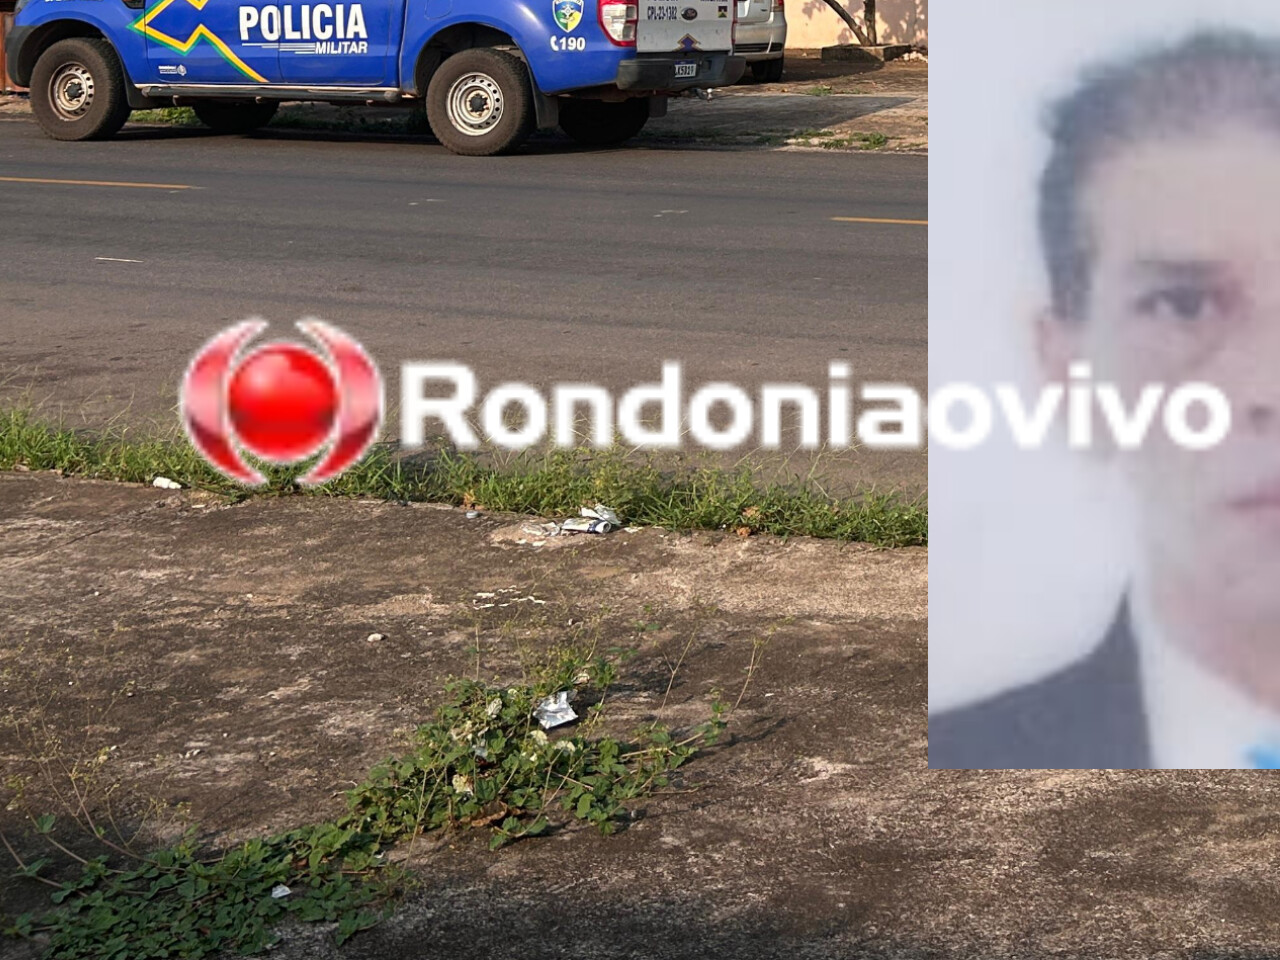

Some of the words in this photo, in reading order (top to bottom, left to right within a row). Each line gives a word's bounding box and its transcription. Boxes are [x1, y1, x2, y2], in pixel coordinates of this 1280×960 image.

[239, 3, 368, 41] POLICIA
[315, 41, 368, 54] MILITAR
[559, 36, 586, 51] 190
